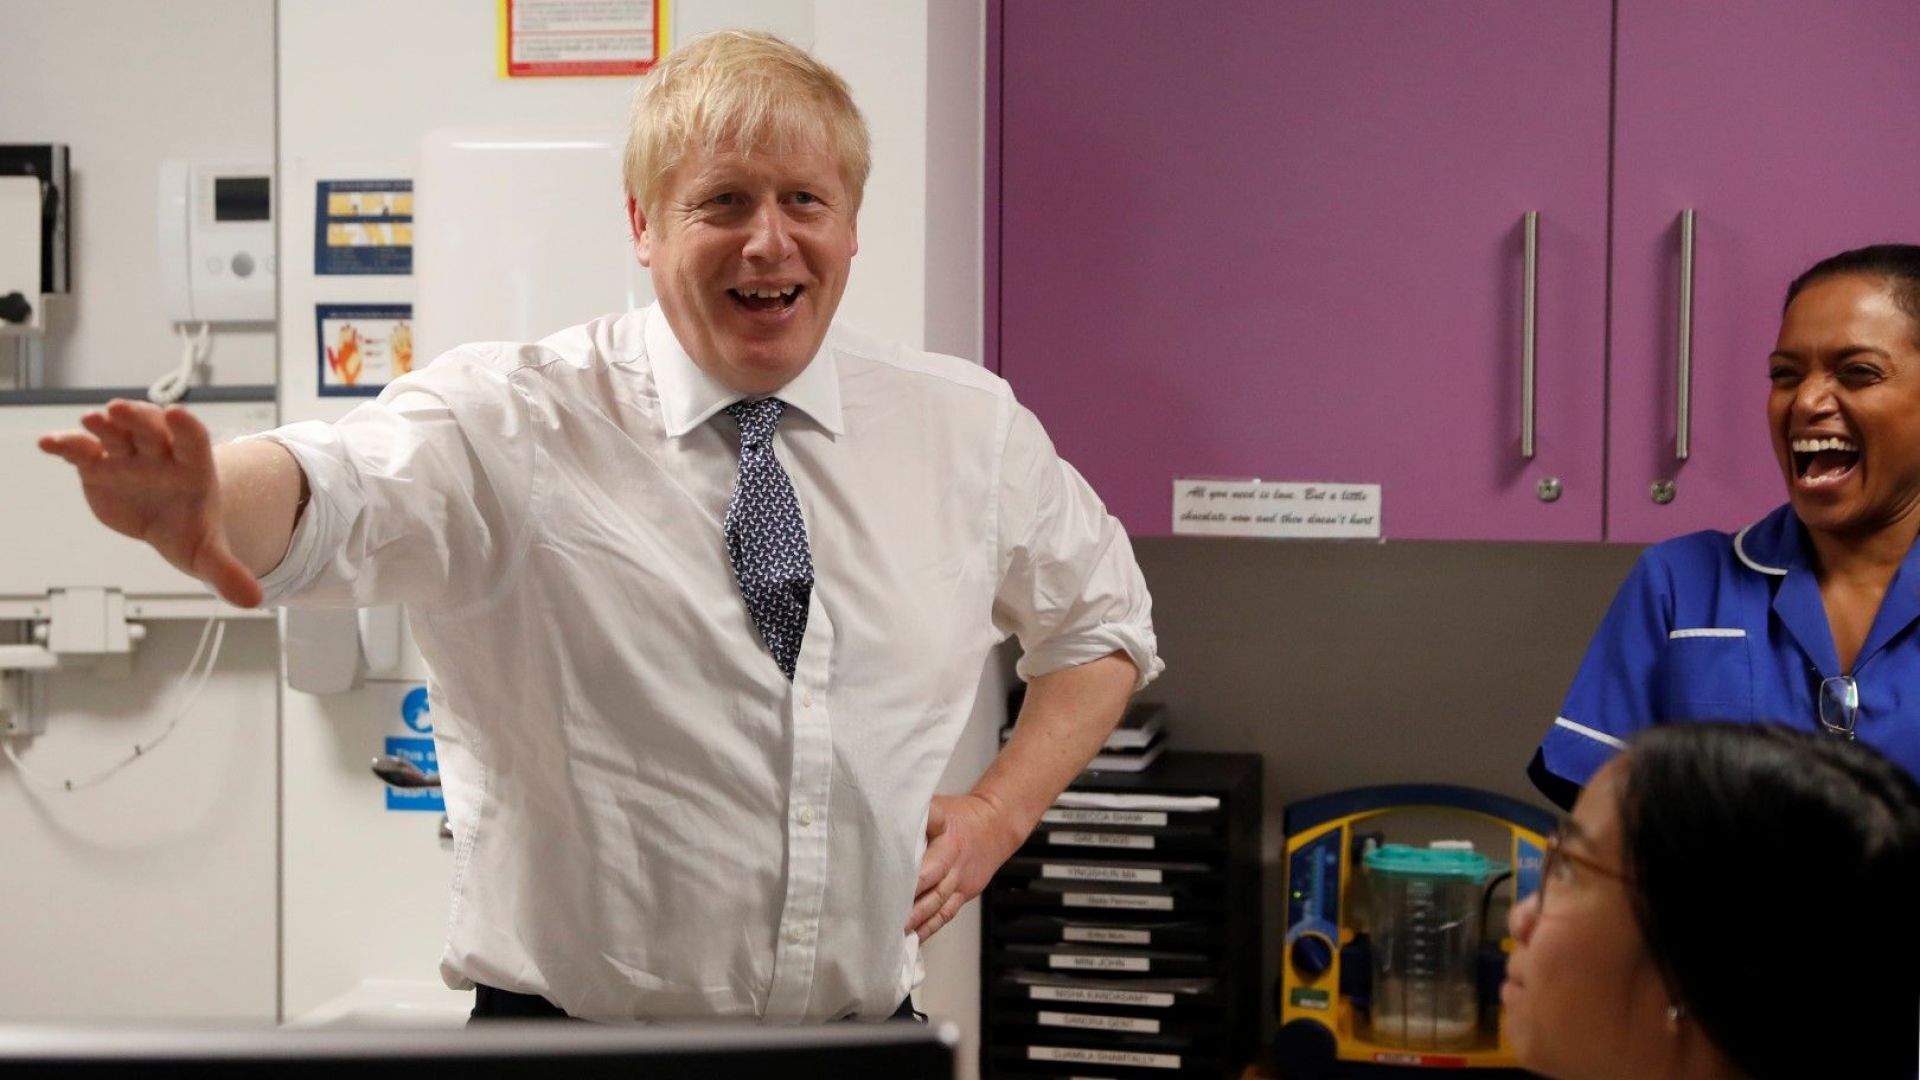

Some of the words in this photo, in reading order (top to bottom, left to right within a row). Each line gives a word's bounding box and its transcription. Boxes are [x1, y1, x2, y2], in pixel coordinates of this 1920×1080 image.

[1186, 486, 1206, 499] All
[1209, 489, 1228, 501] you
[1231, 488, 1256, 500] need
[1259, 489, 1270, 500] is
[1304, 487, 1326, 501] But
[1329, 492, 1338, 501] a
[1341, 488, 1367, 501] little
[1179, 508, 1227, 522] chocolate
[1231, 514, 1251, 523] now
[1256, 512, 1276, 524] and
[1280, 511, 1303, 525] then
[1307, 511, 1346, 525] doesn't
[1349, 512, 1374, 525] hurt
[1061, 811, 1110, 821] REBECCA
